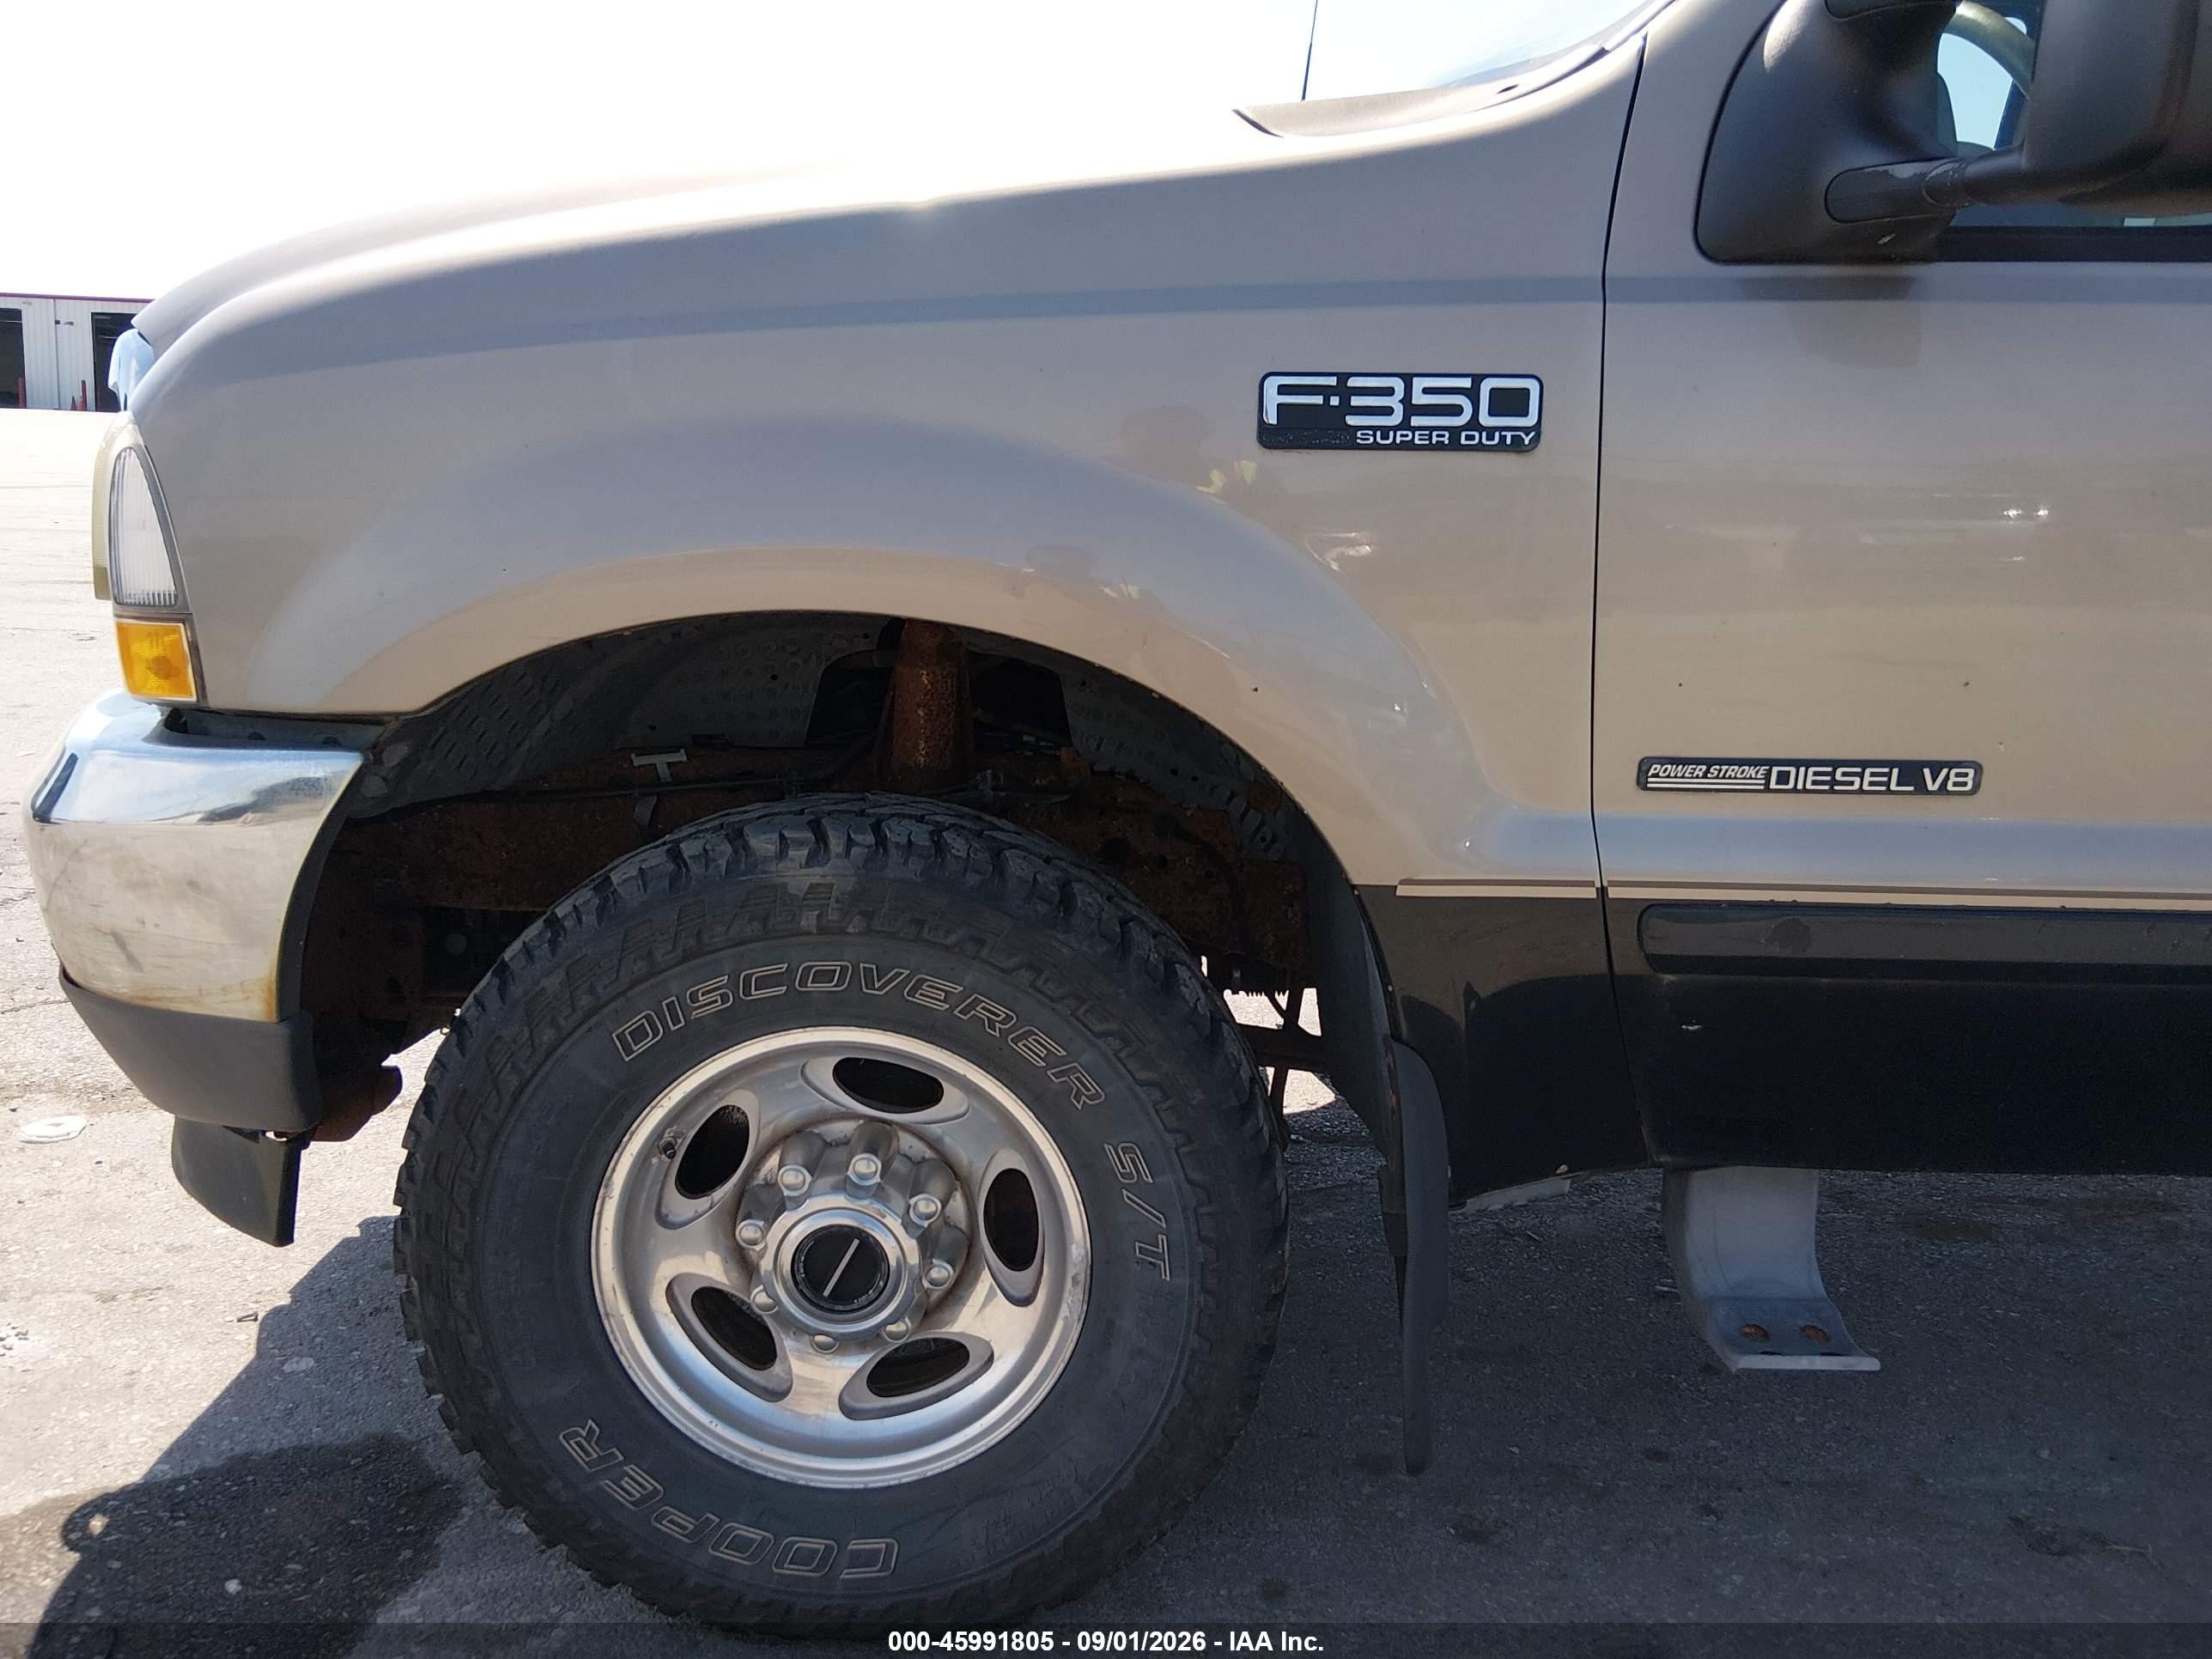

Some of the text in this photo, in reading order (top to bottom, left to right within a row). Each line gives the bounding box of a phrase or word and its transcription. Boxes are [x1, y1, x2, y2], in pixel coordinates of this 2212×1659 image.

[1355, 429, 1536, 446] SUPER DUTY
[1647, 763, 1974, 792] POWER STROKE DIESEL V8
[611, 961, 1170, 1281] DISCOVERER S/T
[559, 1419, 899, 1579] COOPER
